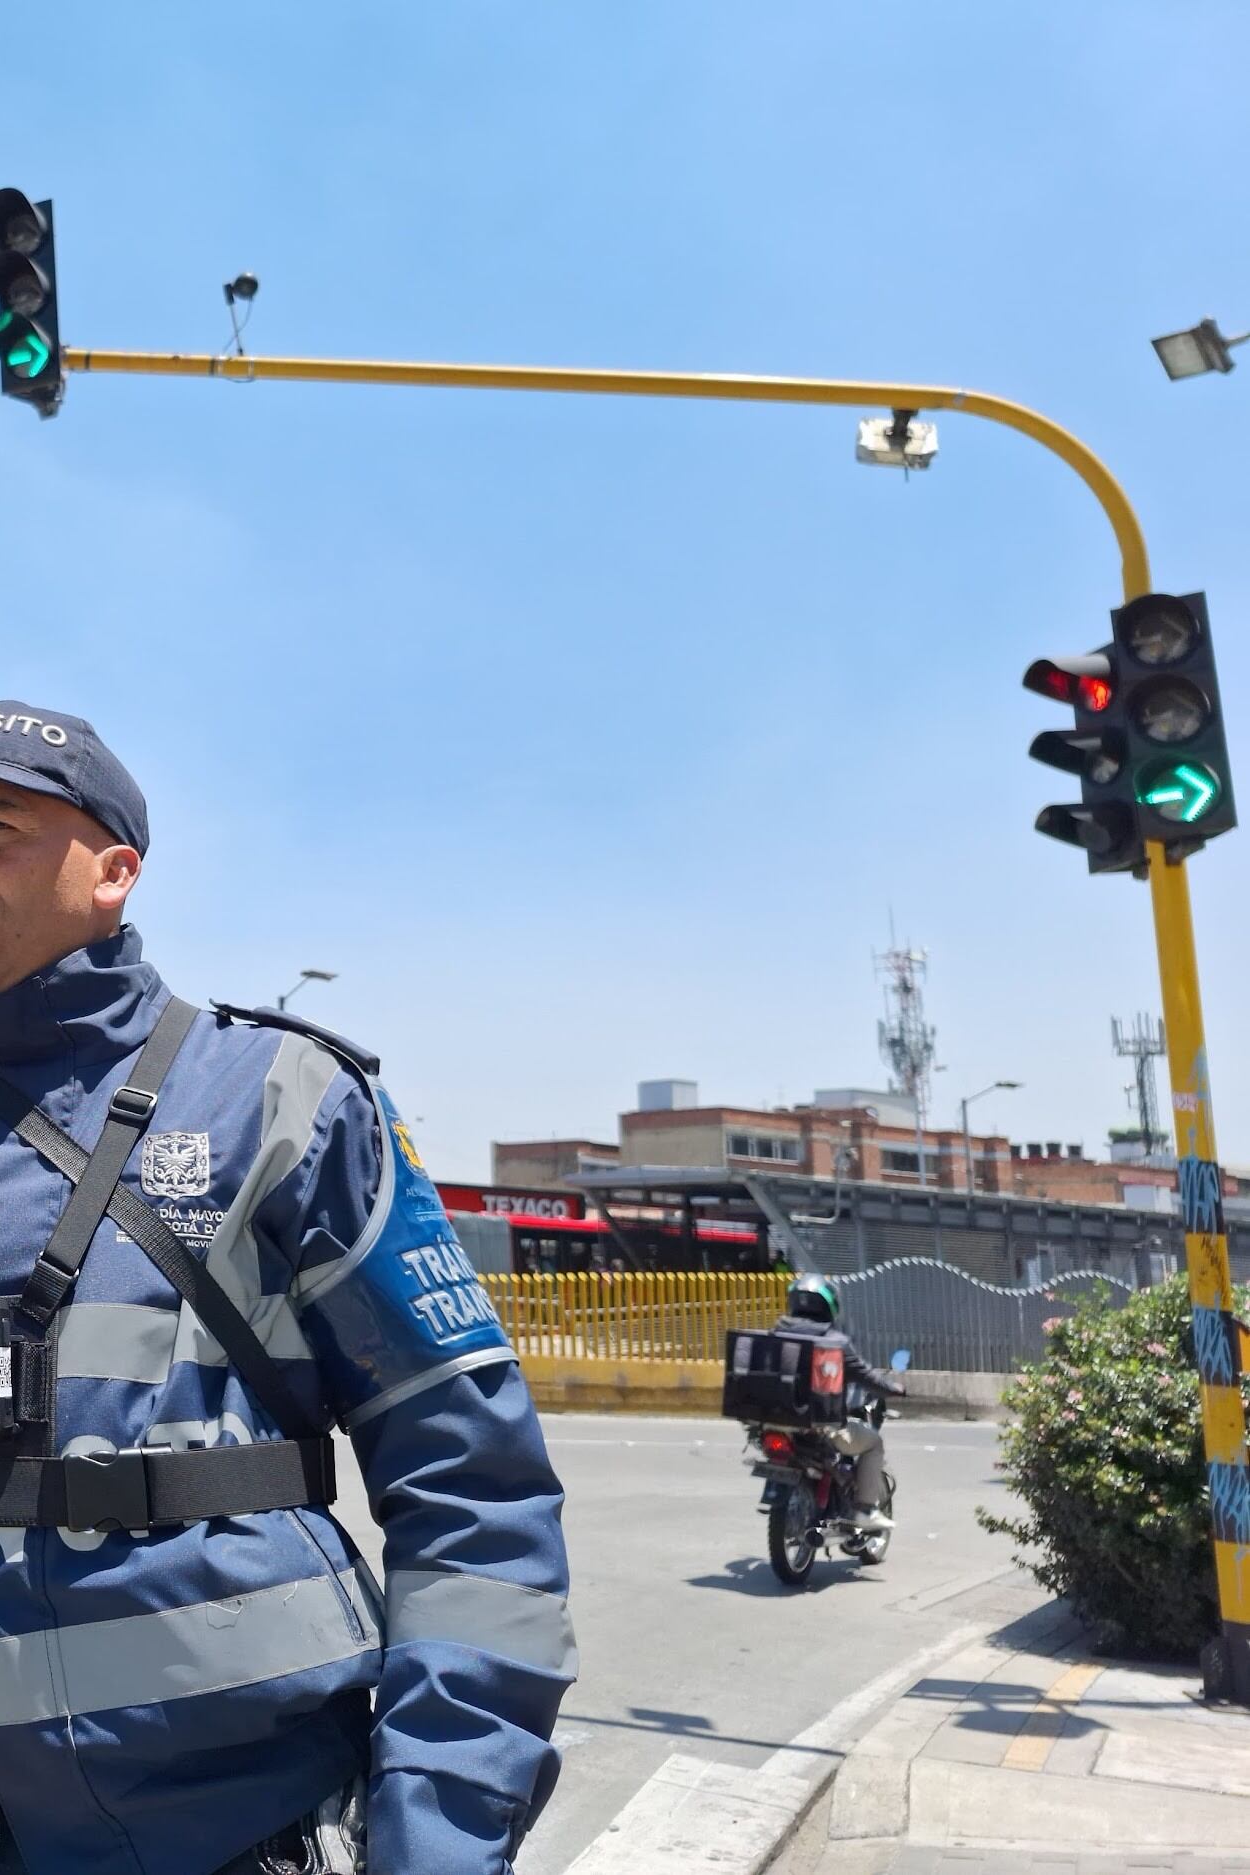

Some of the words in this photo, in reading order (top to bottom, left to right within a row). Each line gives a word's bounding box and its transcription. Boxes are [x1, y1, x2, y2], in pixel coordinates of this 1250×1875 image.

[188, 1208, 227, 1222] MAYO
[482, 1194, 568, 1219] TEXACO
[401, 1234, 478, 1288] TRÁN
